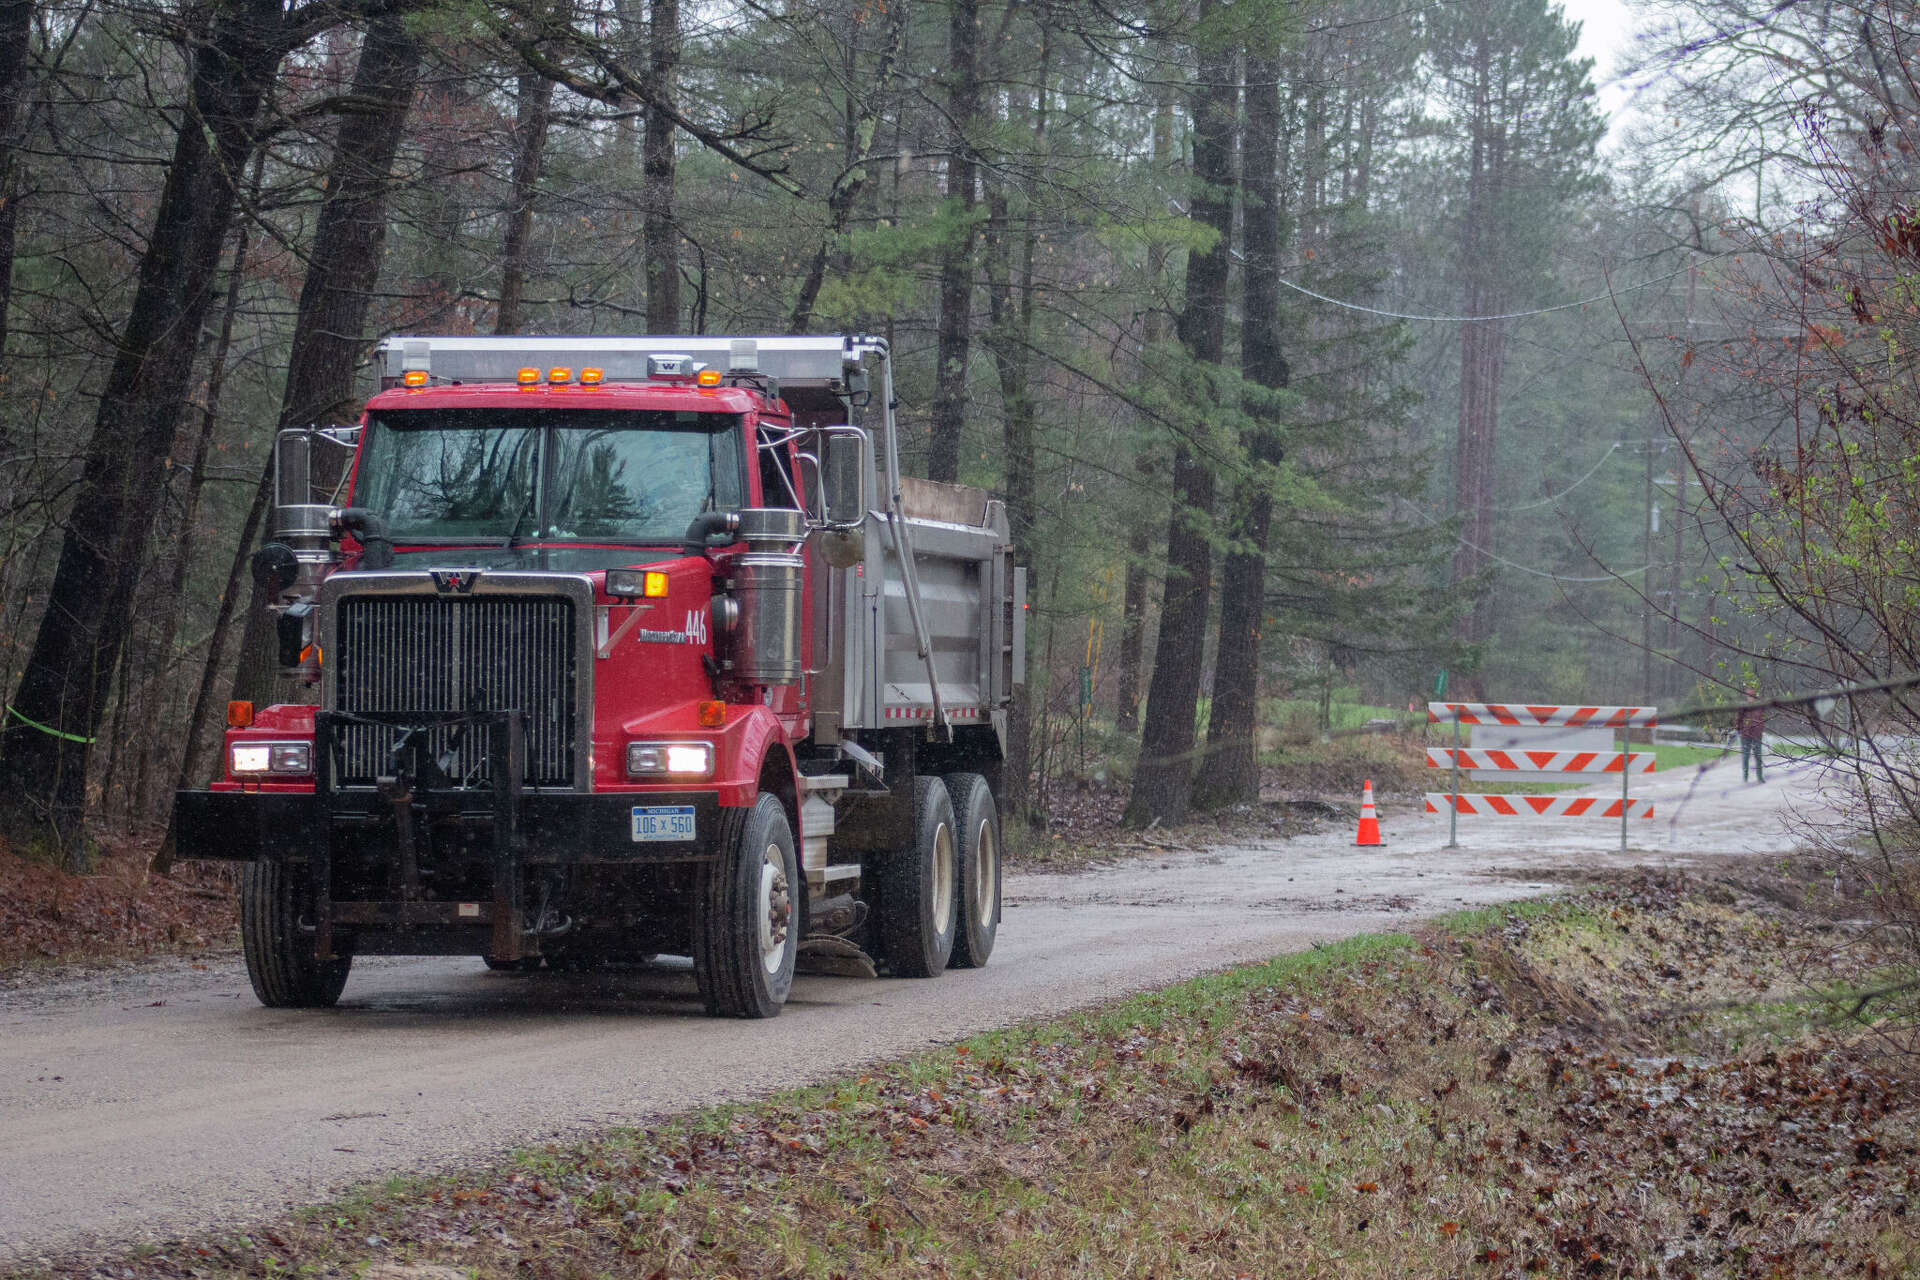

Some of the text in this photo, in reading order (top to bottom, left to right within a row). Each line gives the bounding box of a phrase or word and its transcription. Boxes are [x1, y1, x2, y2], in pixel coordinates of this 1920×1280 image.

[685, 609, 707, 645] 446
[636, 816, 657, 834] 106
[671, 816, 692, 833] 560
